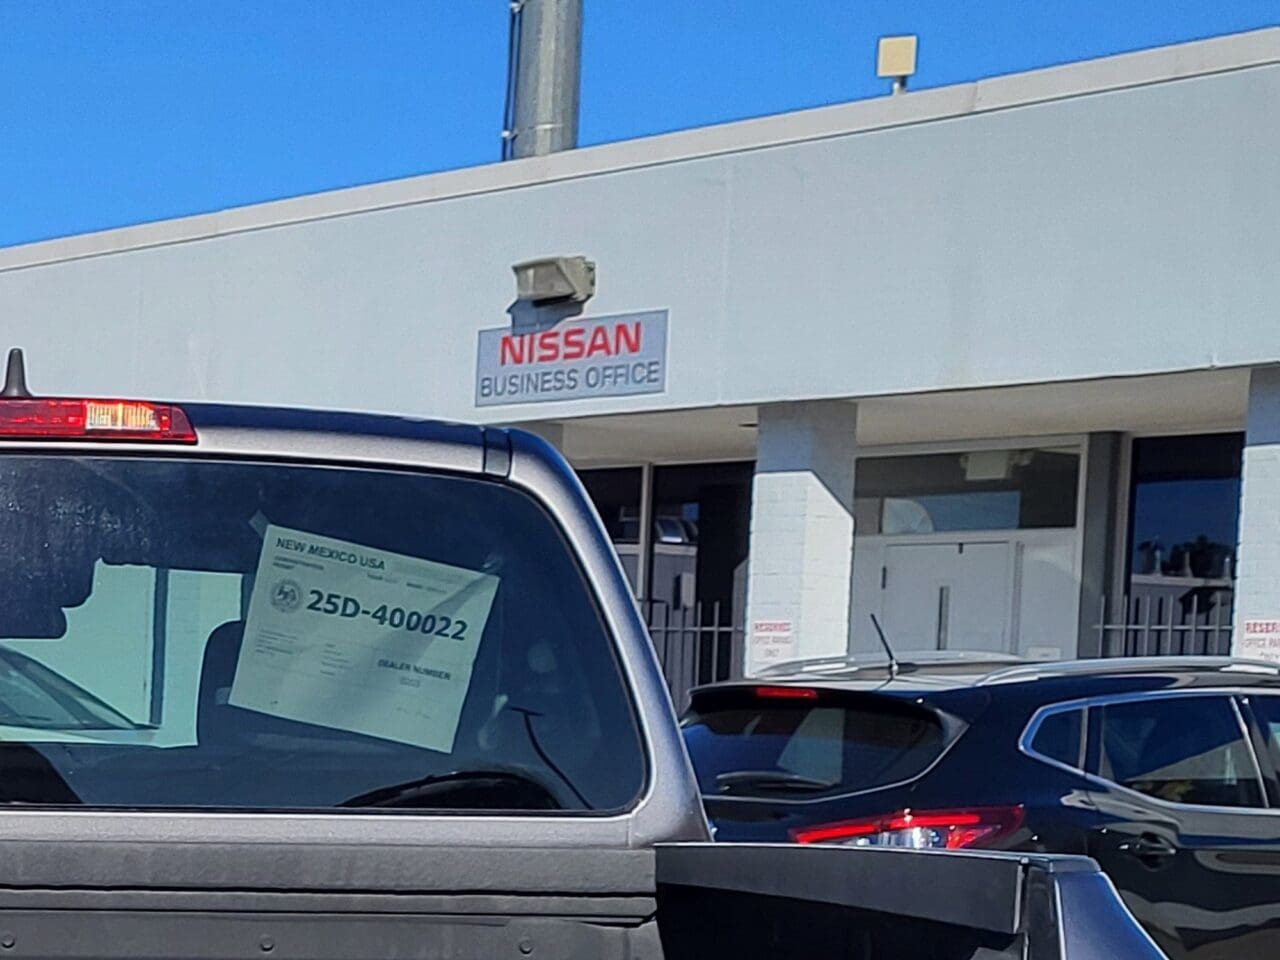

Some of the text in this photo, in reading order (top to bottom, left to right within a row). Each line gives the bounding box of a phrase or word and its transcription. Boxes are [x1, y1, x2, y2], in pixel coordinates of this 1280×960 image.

[500, 322, 641, 366] NISSAN
[481, 361, 660, 397] BUSINESS OFFICE
[276, 537, 306, 553] NEW
[307, 544, 357, 564] MEXICO
[359, 556, 385, 570] USA
[307, 589, 467, 641] 25D-400022
[378, 658, 451, 680] DEALER NUMBER
